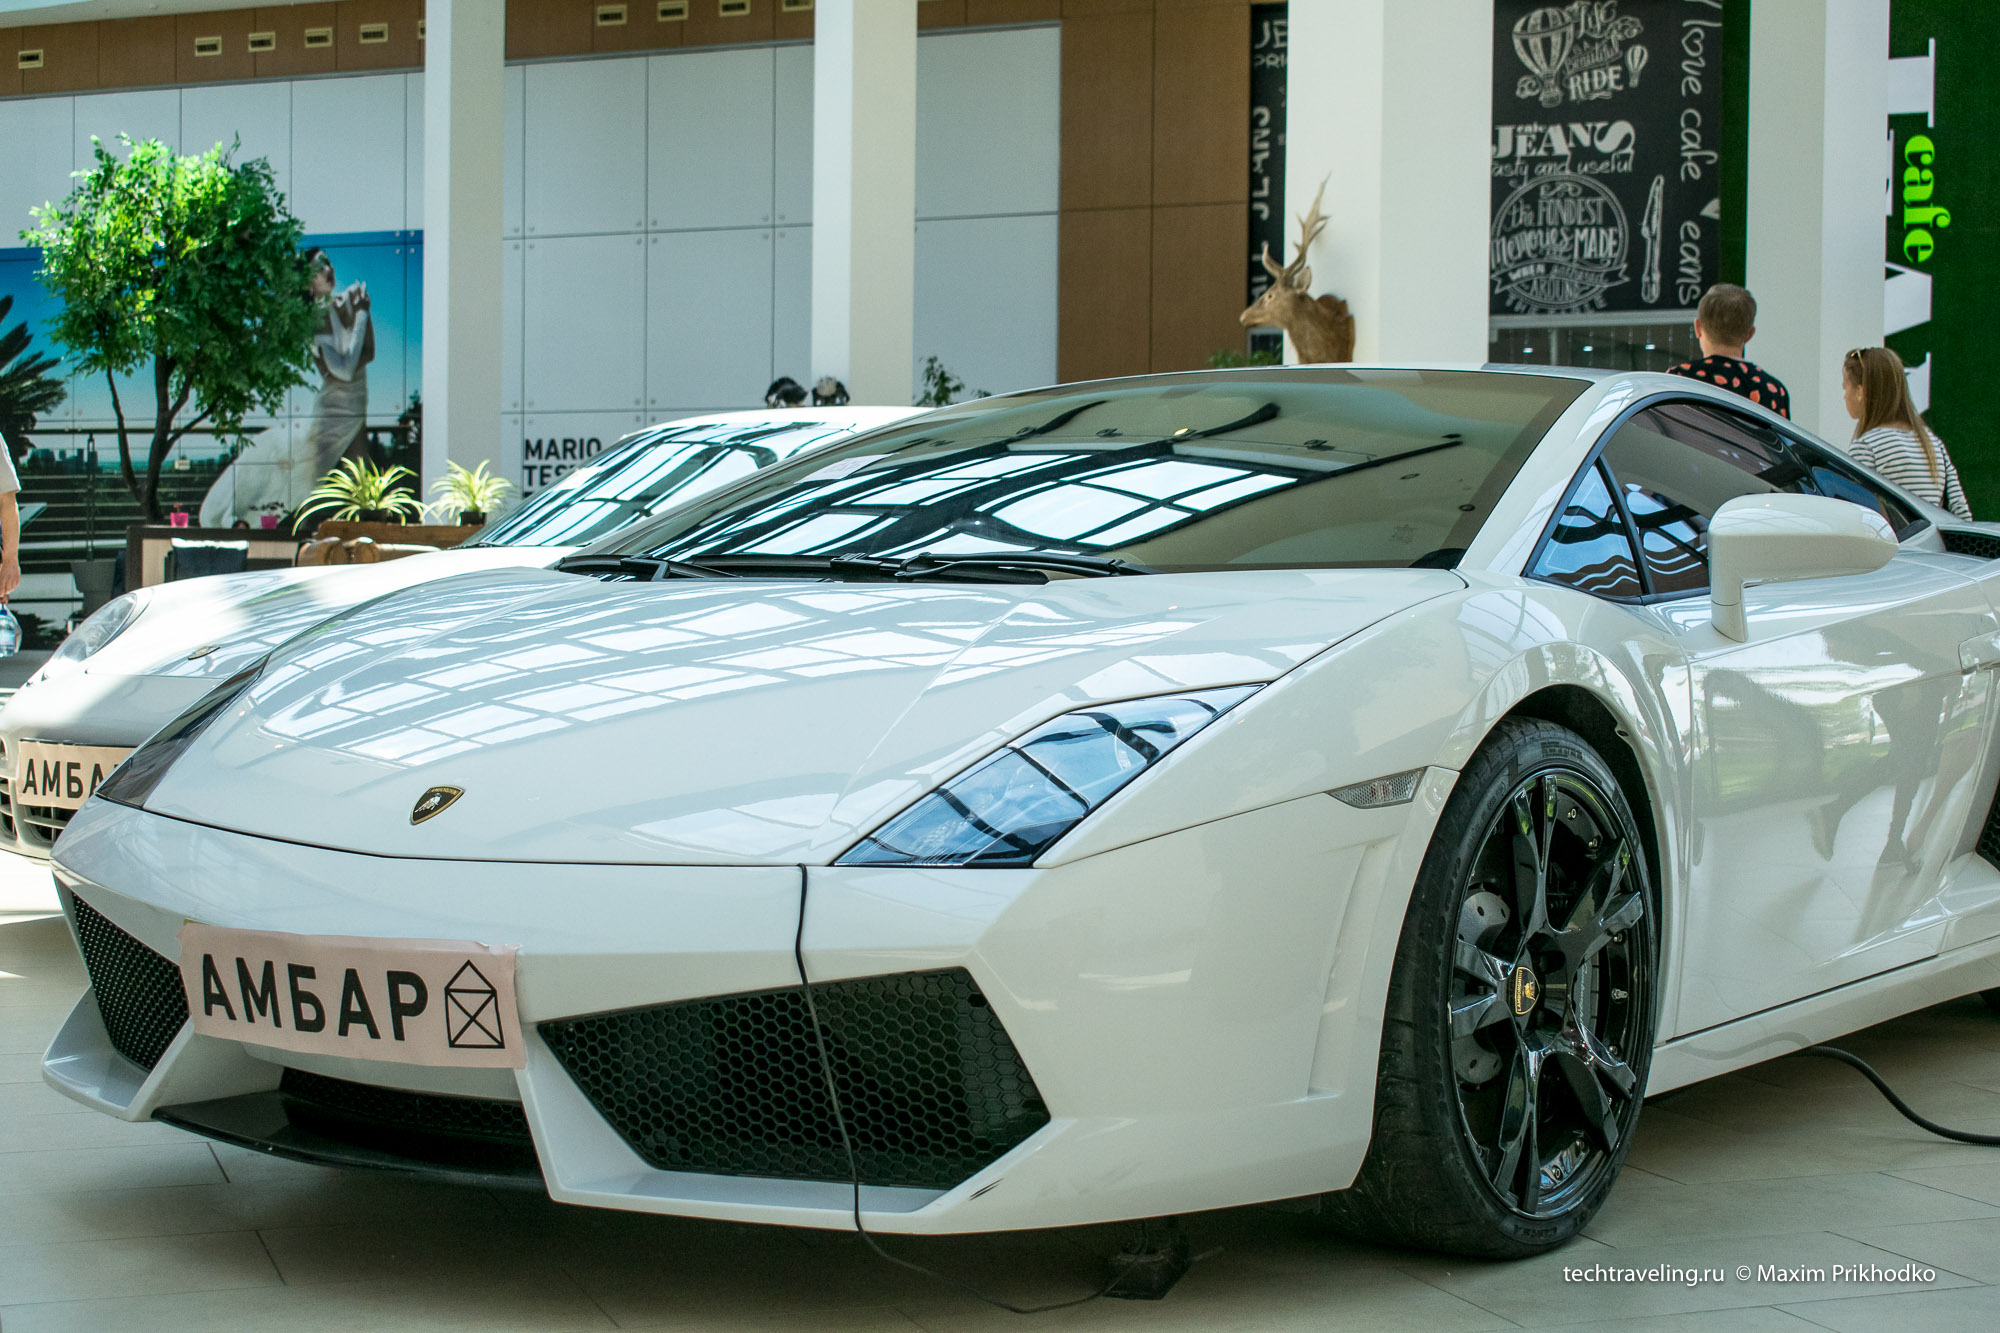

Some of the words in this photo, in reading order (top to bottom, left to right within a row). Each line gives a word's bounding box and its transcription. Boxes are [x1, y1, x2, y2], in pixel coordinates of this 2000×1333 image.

[1569, 65, 1624, 101] RIDE
[1492, 120, 1635, 158] JEANS
[1680, 108, 1719, 182] cafe
[1491, 159, 1529, 185] asty
[1535, 156, 1572, 175] and
[1577, 151, 1635, 174] useful
[1903, 134, 1951, 263] cafe
[1574, 227, 1618, 260] MADE
[524, 437, 602, 460] MARIO
[22, 758, 118, 799] АМБА
[203, 953, 429, 1041] АМБАР
